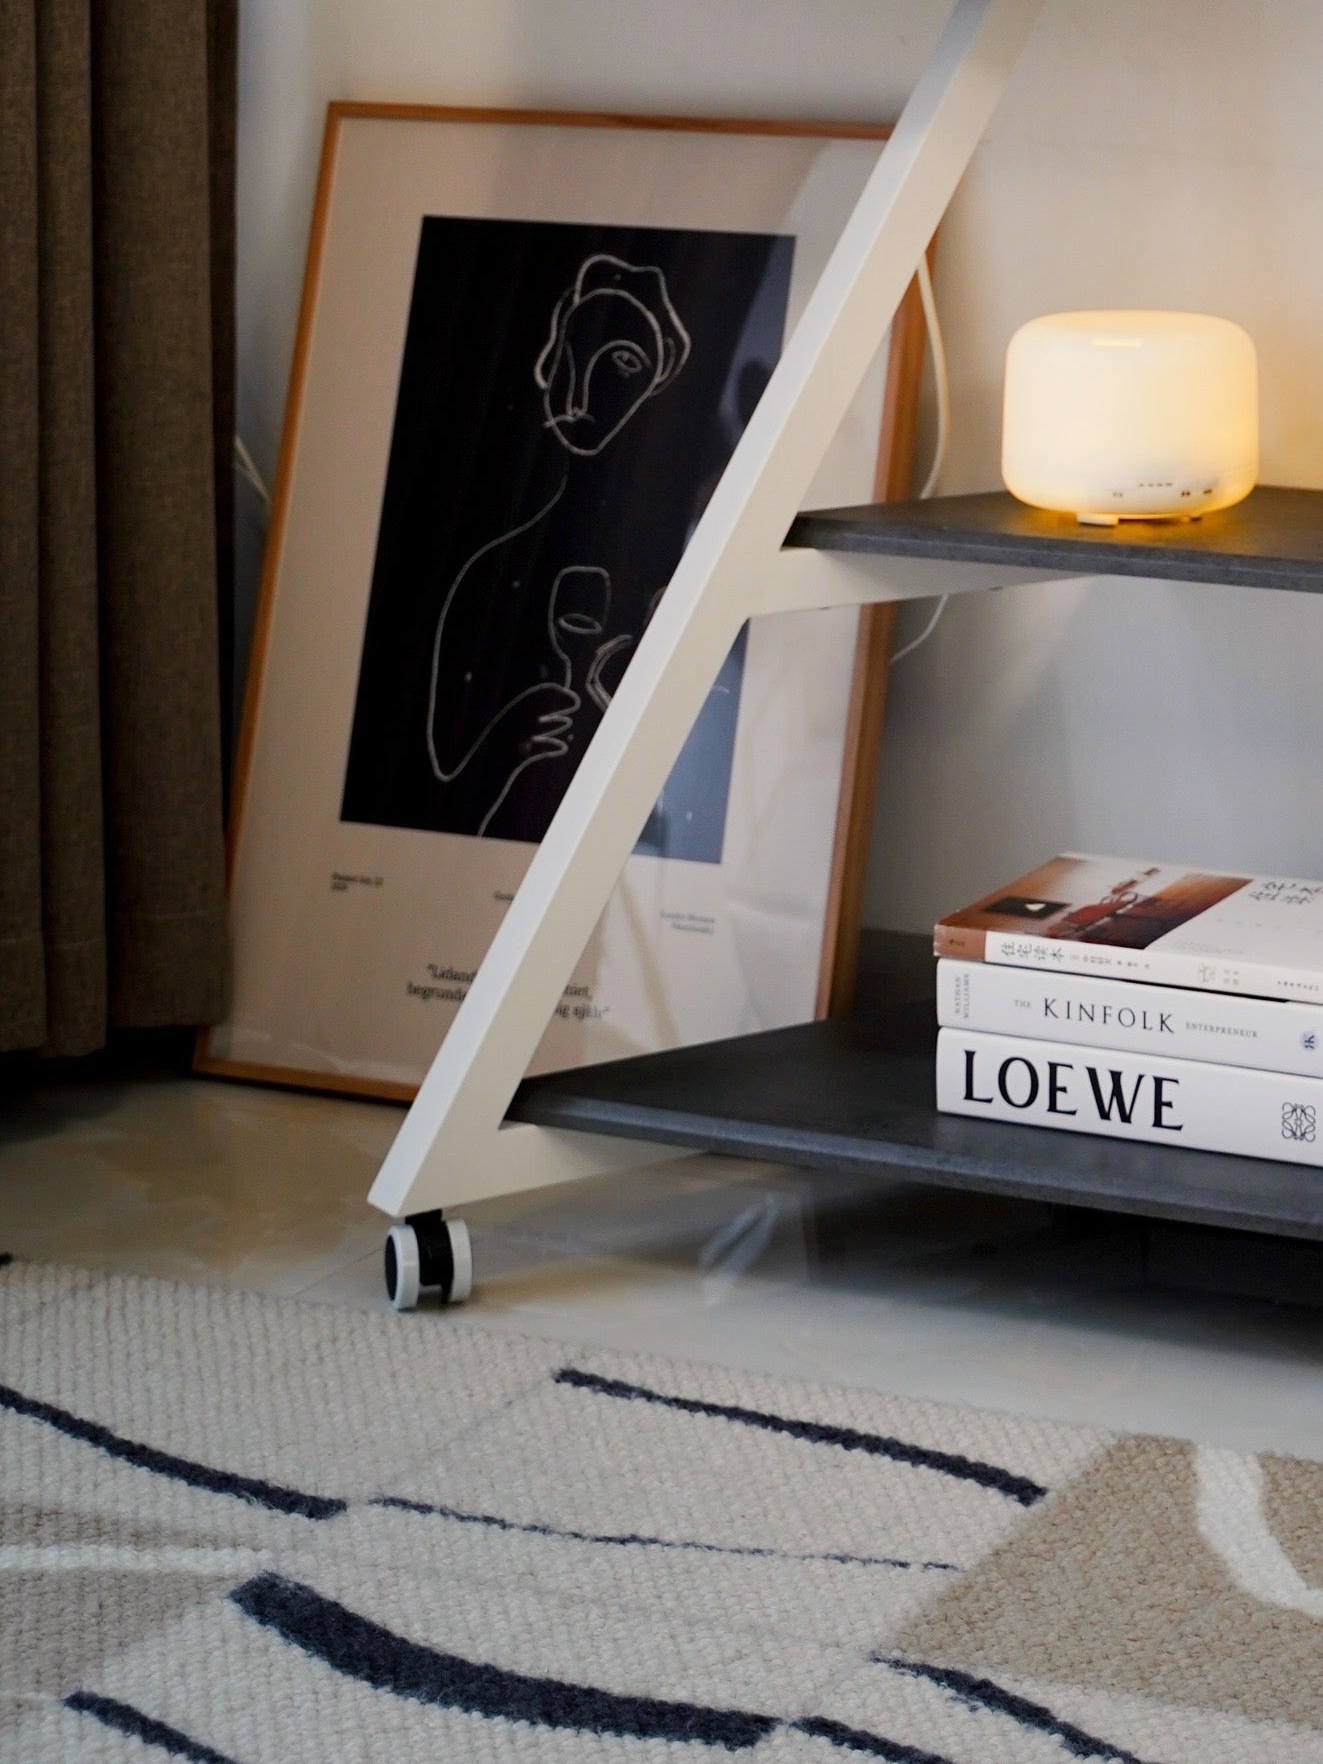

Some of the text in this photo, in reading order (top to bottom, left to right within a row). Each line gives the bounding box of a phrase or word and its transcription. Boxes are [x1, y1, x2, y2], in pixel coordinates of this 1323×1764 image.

[1014, 998, 1032, 1010] THE
[1043, 997, 1176, 1034] KINFOLK
[963, 1048, 1184, 1132] LOEWE
